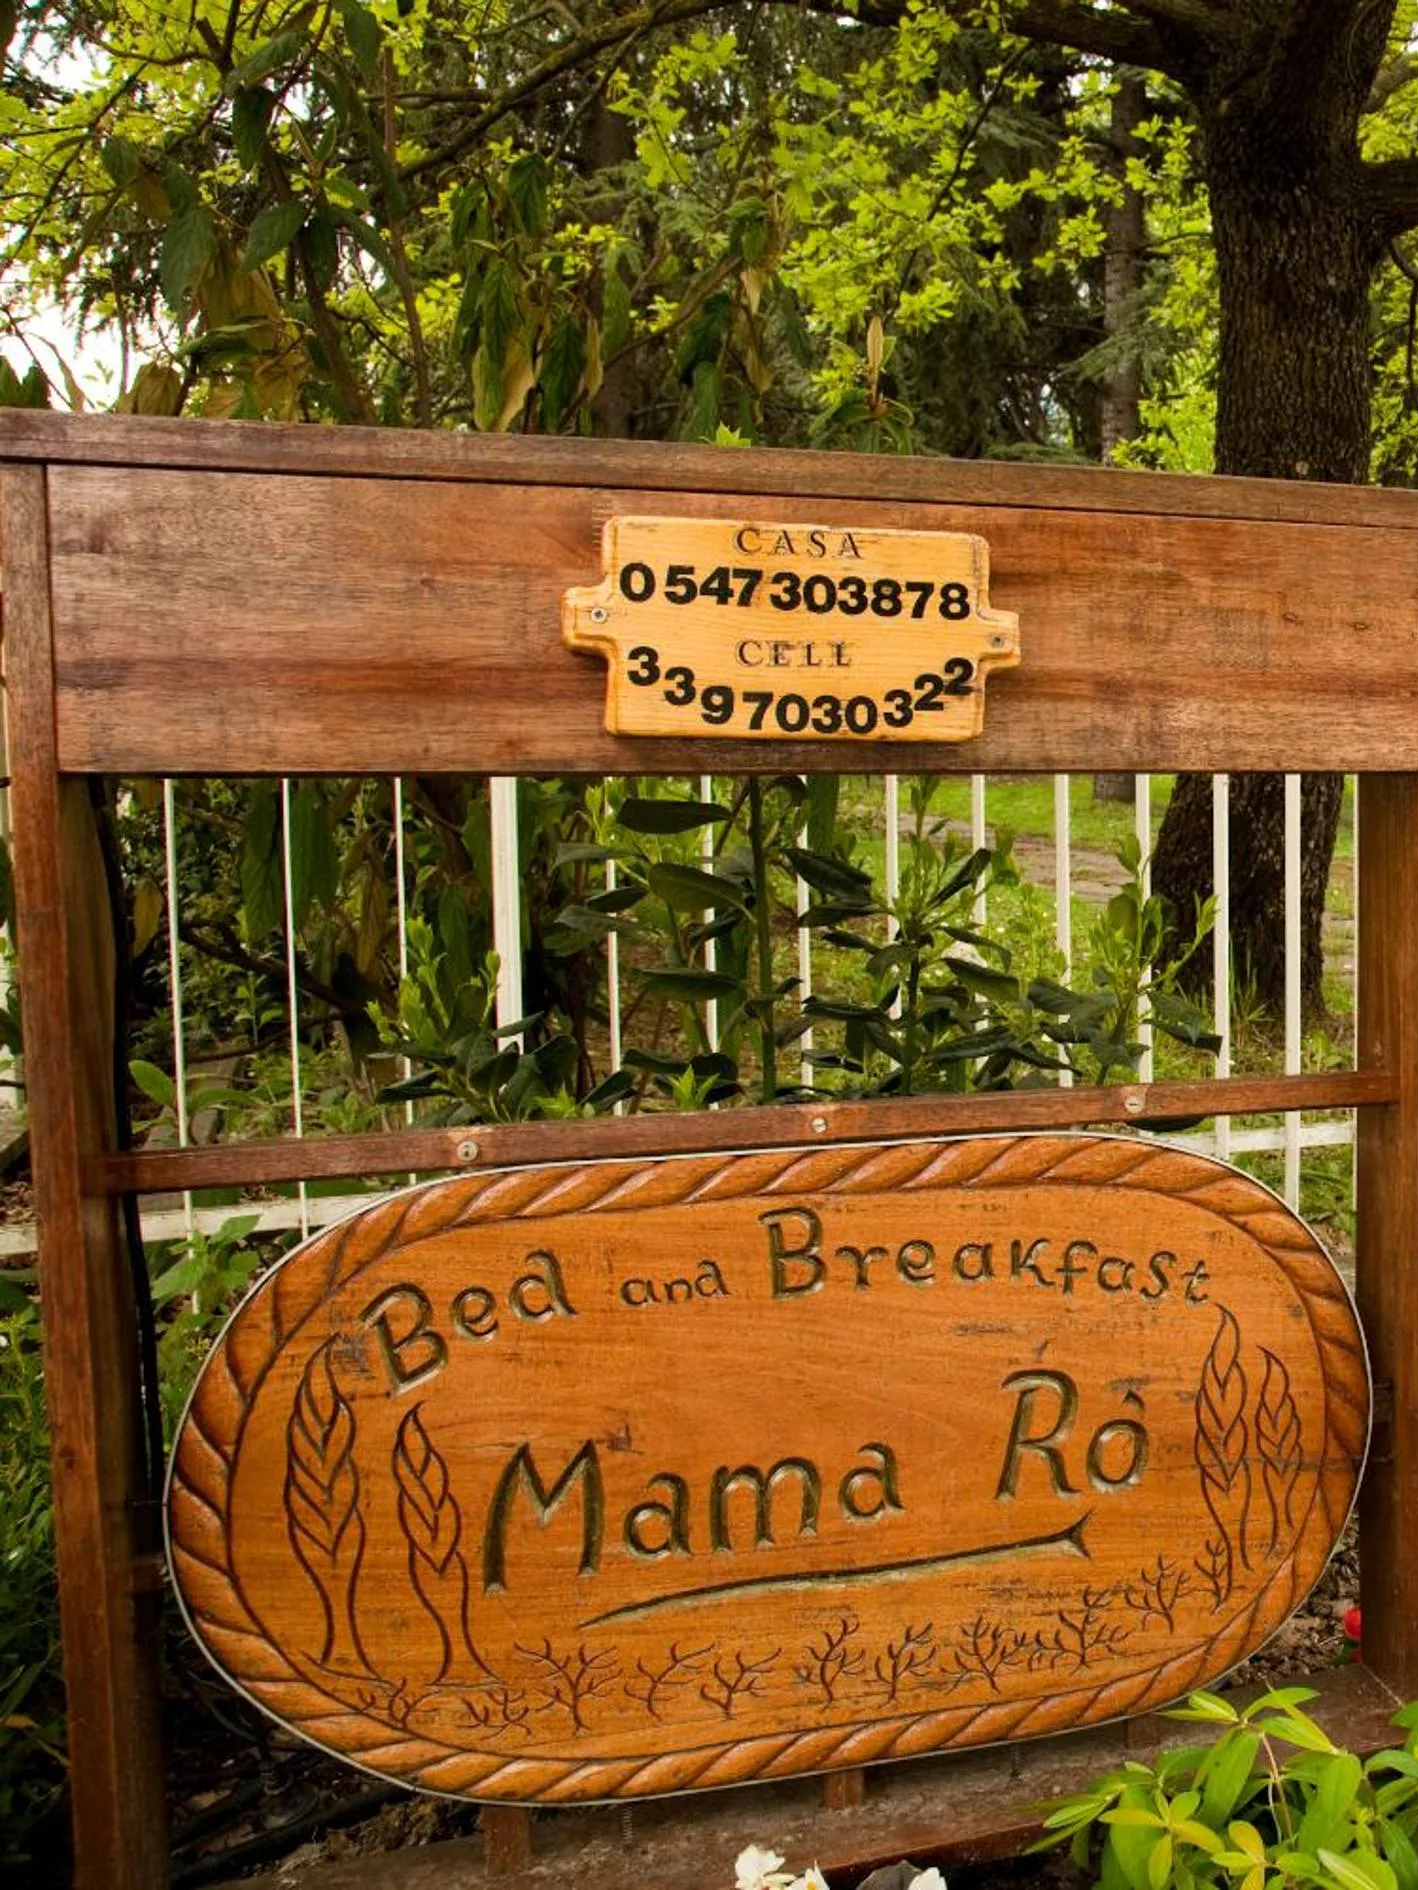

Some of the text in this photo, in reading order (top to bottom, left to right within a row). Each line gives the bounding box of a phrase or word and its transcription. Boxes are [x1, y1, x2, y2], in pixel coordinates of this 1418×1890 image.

[734, 527, 862, 559] CASA
[735, 640, 855, 668] CELL
[360, 1206, 1211, 1394] Bed and Breakfast
[483, 1440, 905, 1593] Mama
